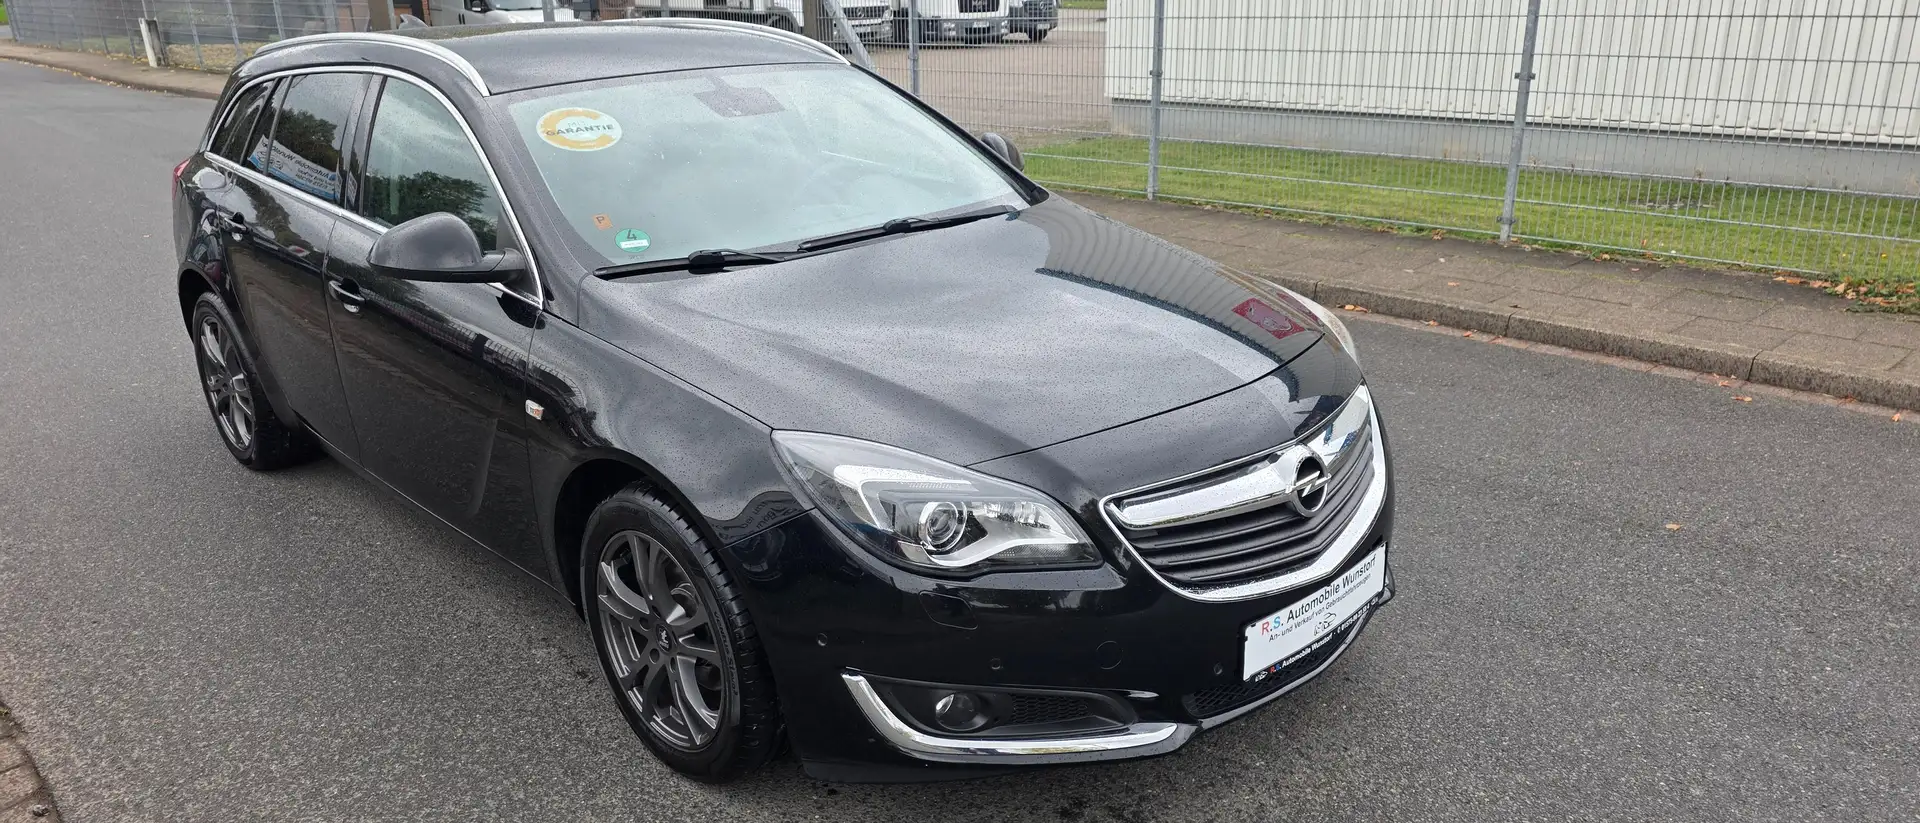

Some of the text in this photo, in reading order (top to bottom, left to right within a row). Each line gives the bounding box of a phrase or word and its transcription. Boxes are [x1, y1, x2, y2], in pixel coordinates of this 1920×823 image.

[546, 123, 615, 137] GARANTIE
[596, 216, 605, 224] P
[626, 228, 638, 241] 4
[1261, 616, 1284, 636] R.S.
[1287, 583, 1340, 624] Automobile
[1342, 554, 1377, 590] Wunstorf
[1268, 632, 1281, 643] An-
[1281, 625, 1294, 637] und
[1295, 611, 1316, 630] Verkauf
[1315, 606, 1326, 616] von
[1282, 647, 1311, 668] Automobile
